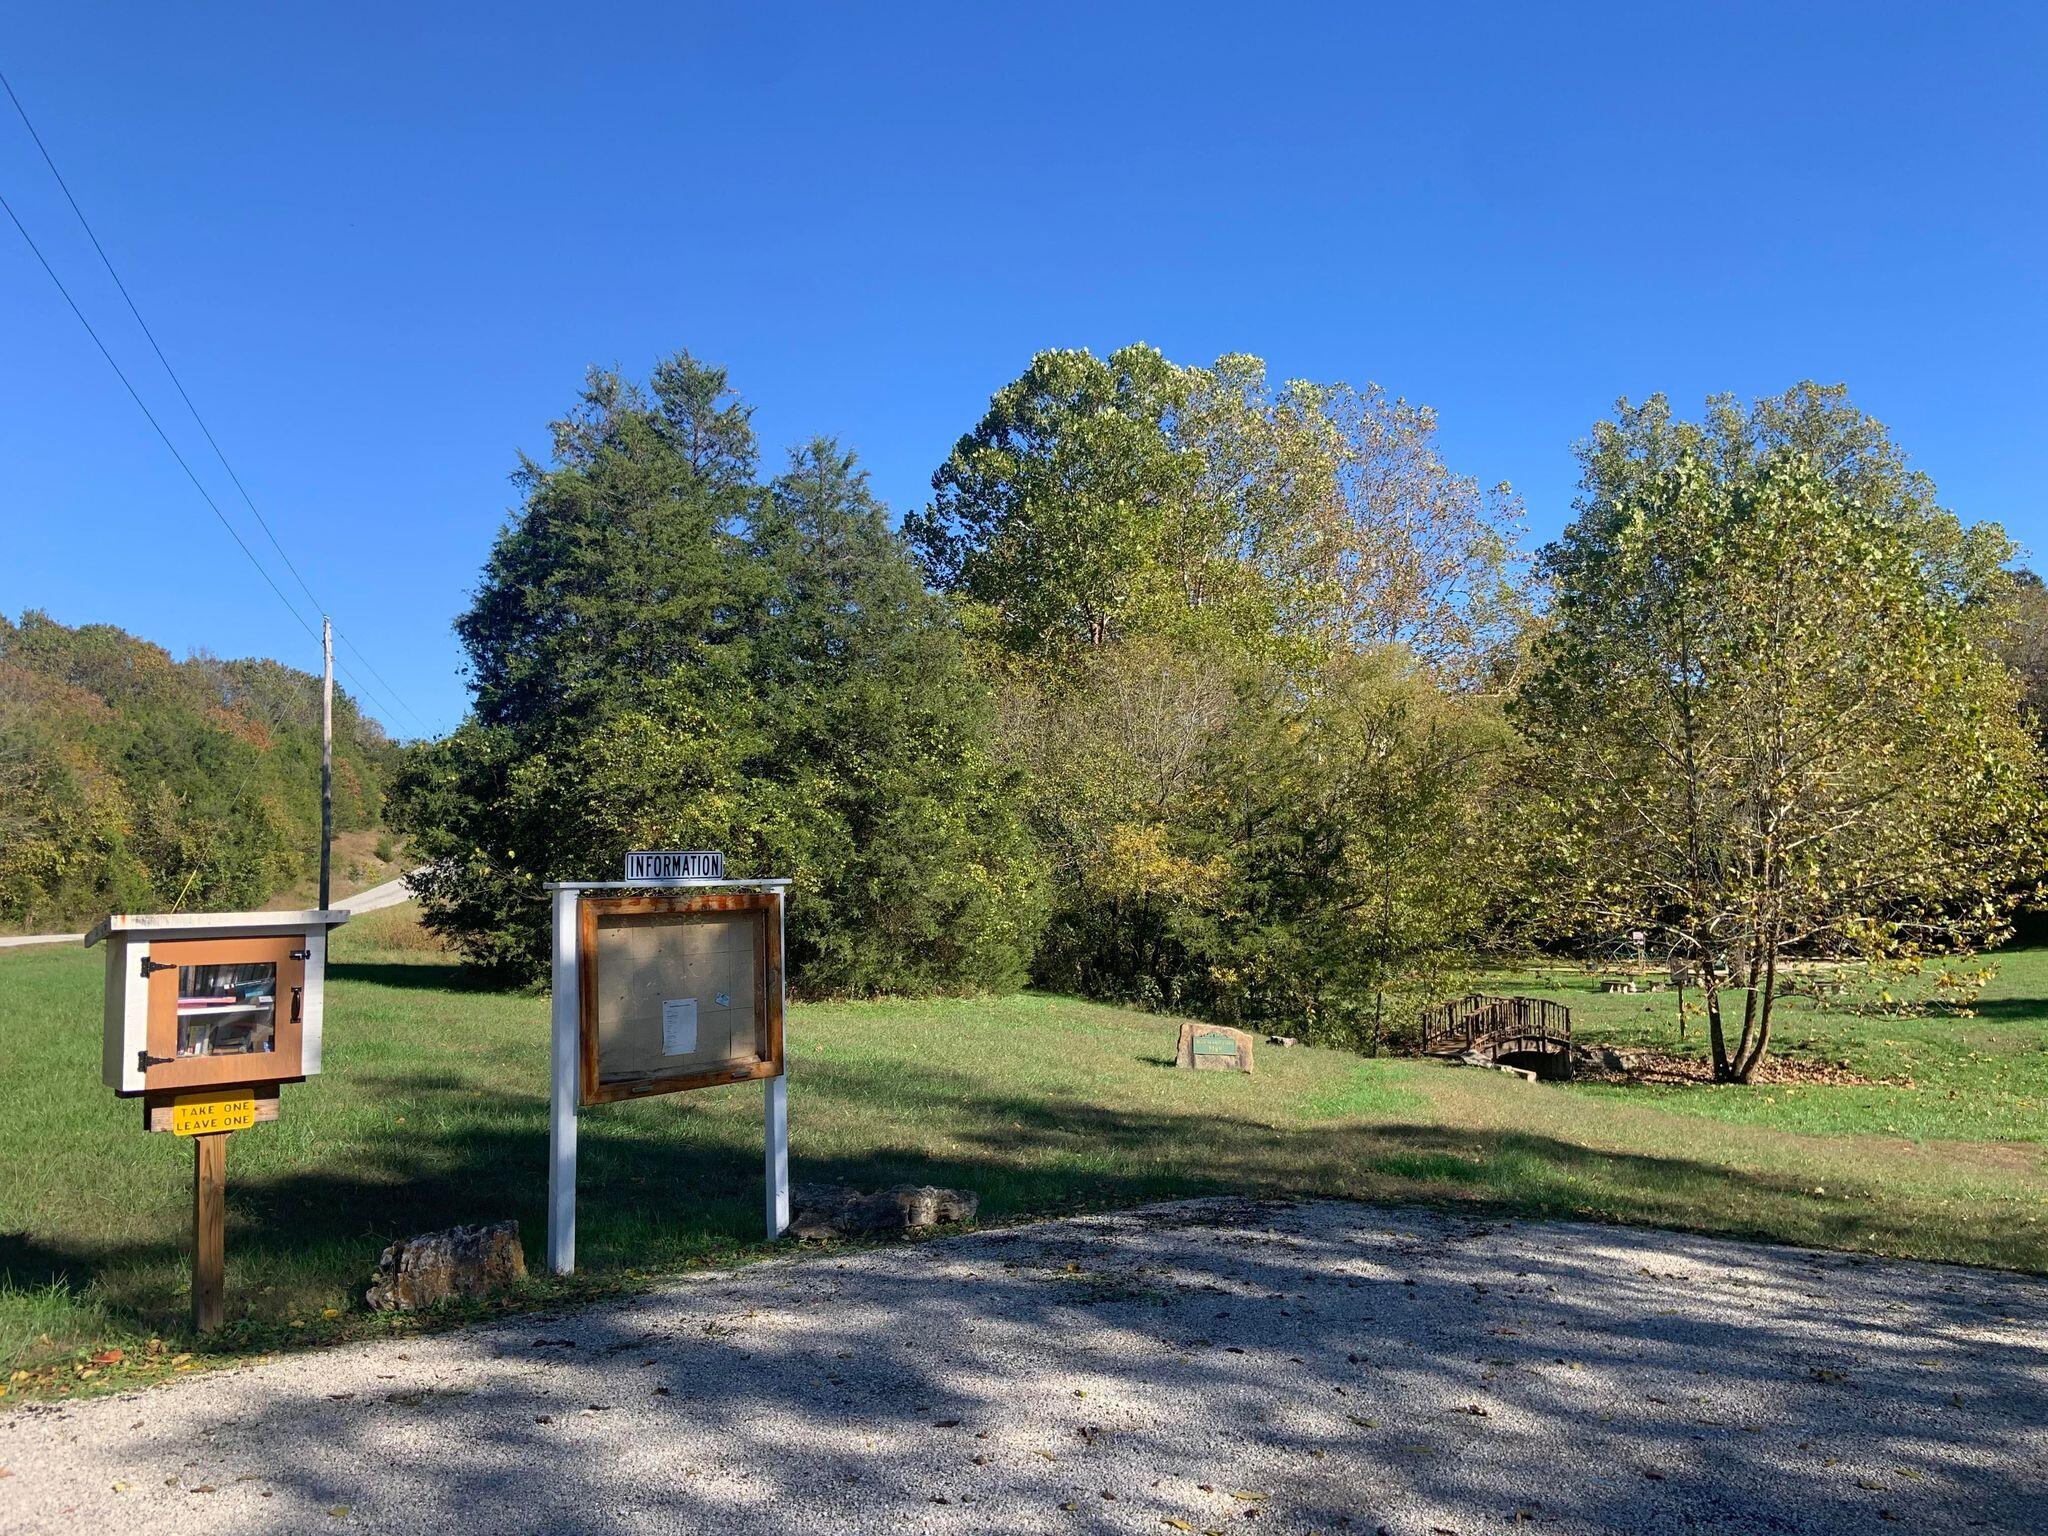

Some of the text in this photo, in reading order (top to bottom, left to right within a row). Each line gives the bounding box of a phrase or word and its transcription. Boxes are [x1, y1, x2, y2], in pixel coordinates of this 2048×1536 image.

[631, 855, 719, 877] INFORMATION
[181, 1102, 249, 1117] TAKE ONE
[177, 1116, 249, 1131] LEAVE ONE
